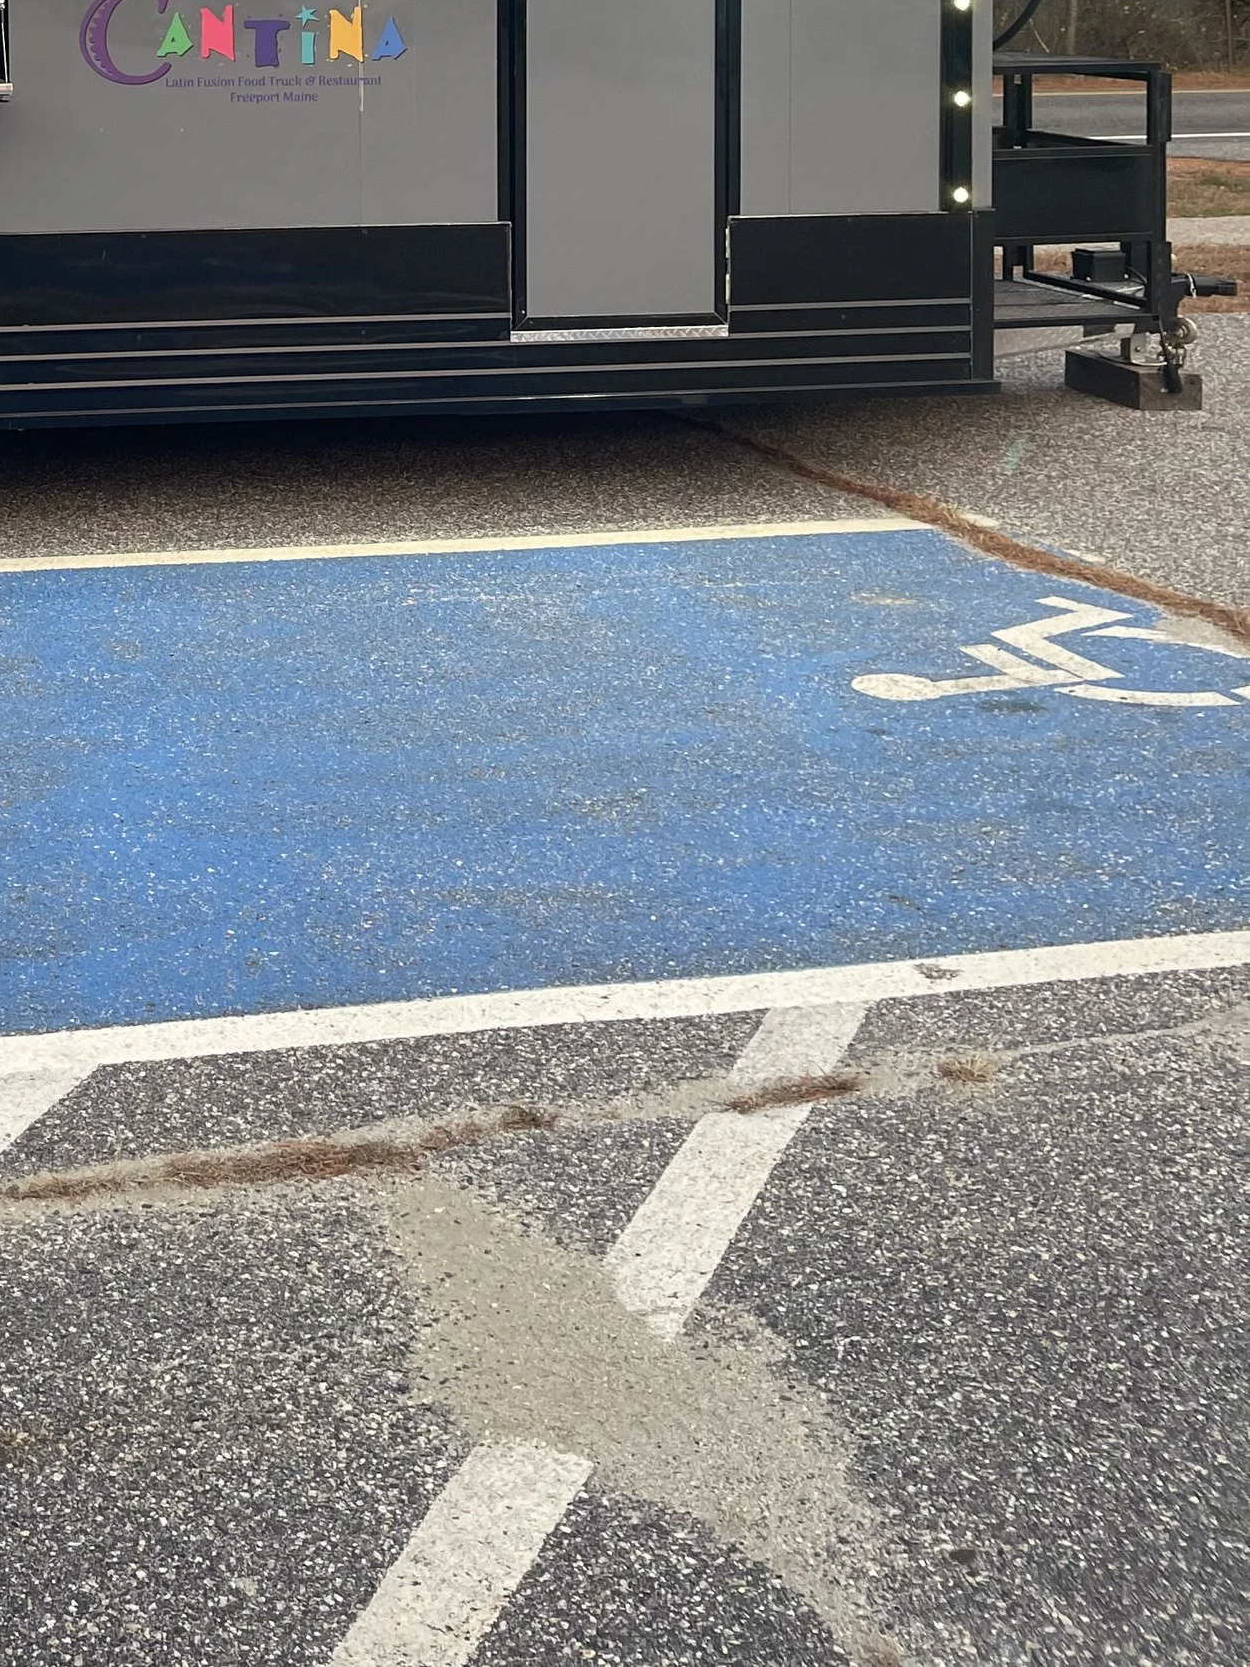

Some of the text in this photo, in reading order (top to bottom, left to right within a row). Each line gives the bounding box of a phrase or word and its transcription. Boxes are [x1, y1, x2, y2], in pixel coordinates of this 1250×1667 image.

[165, 75, 382, 87] Latin Fusion Food Truck & Restaurant
[230, 91, 318, 105] Freeport Maine
